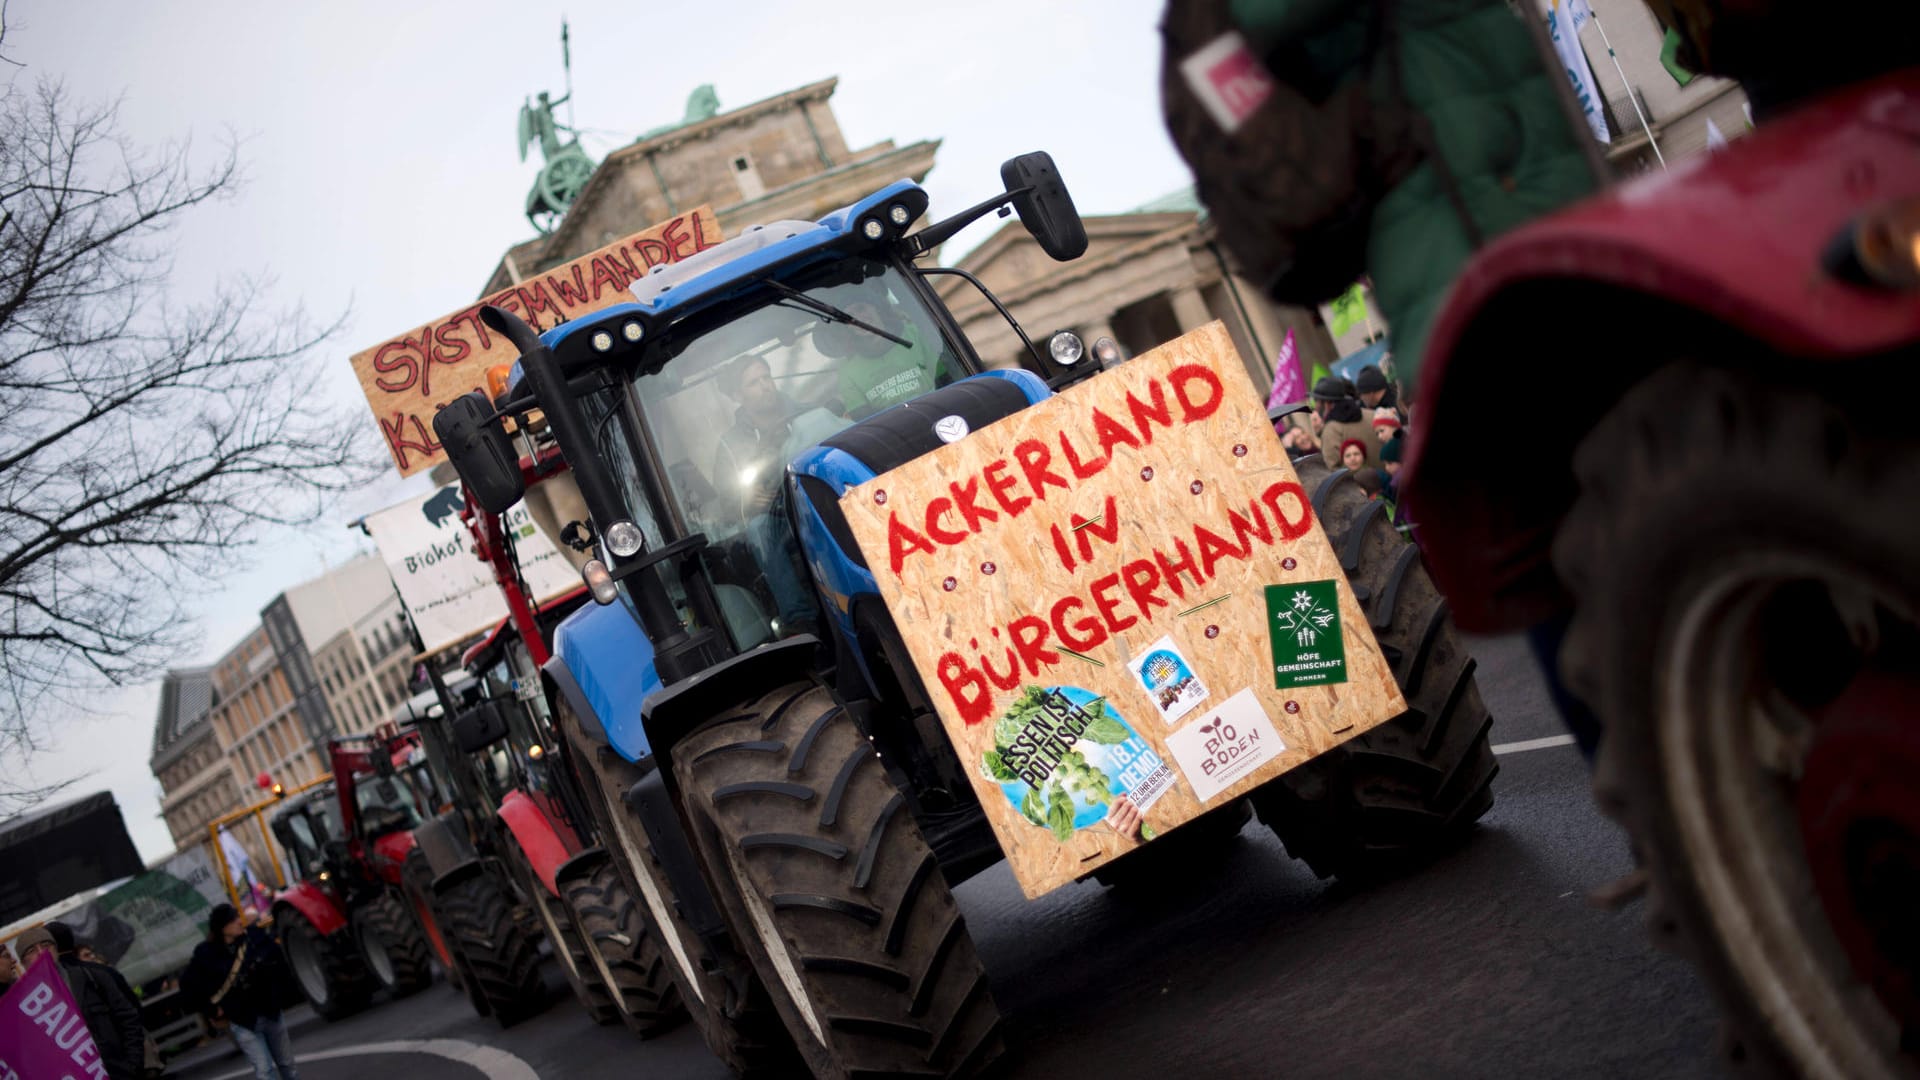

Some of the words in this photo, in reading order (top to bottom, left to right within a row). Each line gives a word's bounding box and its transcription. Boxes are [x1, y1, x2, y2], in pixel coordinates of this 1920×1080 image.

[373, 212, 721, 396] SYSTEMWANDEL
[887, 364, 1225, 576] ACKERLAND
[404, 532, 464, 574] Biohof
[1051, 496, 1119, 574] IN
[937, 482, 1314, 726] BÜRGERHAND
[1277, 660, 1341, 672] GEMEINSCHAFT
[1296, 653, 1320, 661] HÖFE
[1001, 714, 1049, 776] ESSEN
[1041, 686, 1074, 723] IST
[1020, 705, 1094, 791] POLITISCH
[1201, 728, 1260, 776] BODEN
[1204, 724, 1237, 757] BIO
[1118, 750, 1159, 791] DEMO
[1130, 791, 1140, 802] 12
[1137, 781, 1151, 797] UHR
[1148, 764, 1169, 785] BERLIN
